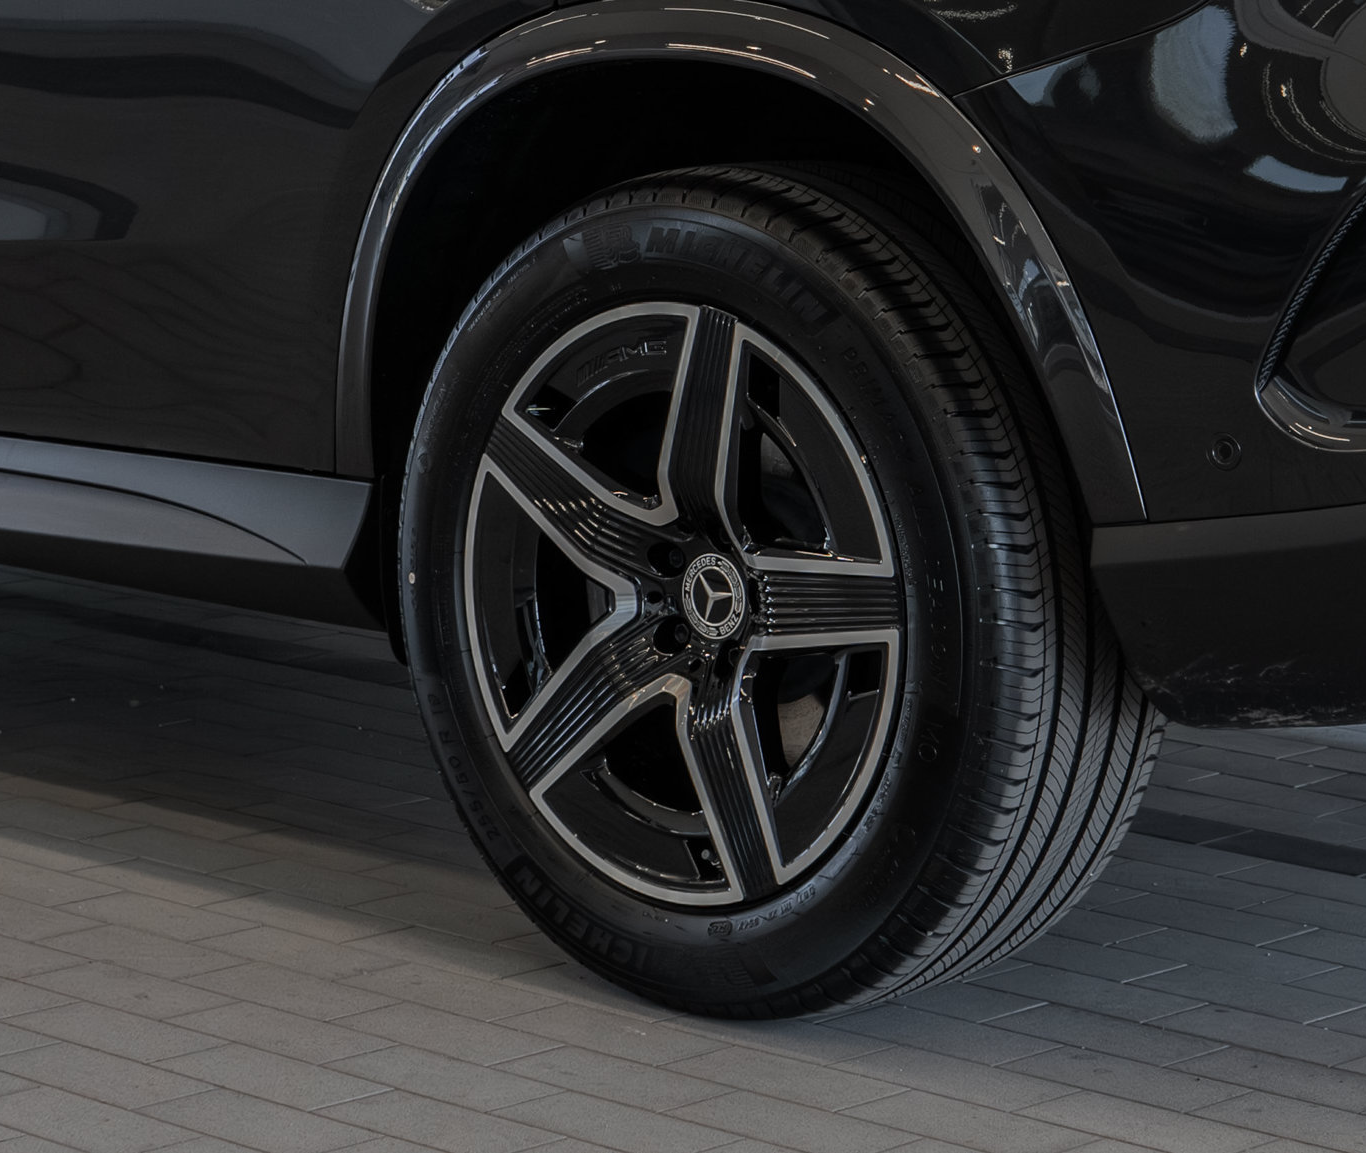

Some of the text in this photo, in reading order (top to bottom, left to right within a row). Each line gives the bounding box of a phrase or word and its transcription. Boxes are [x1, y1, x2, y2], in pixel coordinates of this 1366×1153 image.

[641, 217, 830, 331] MICHELIN
[685, 557, 739, 635] MERCEDES BENZ
